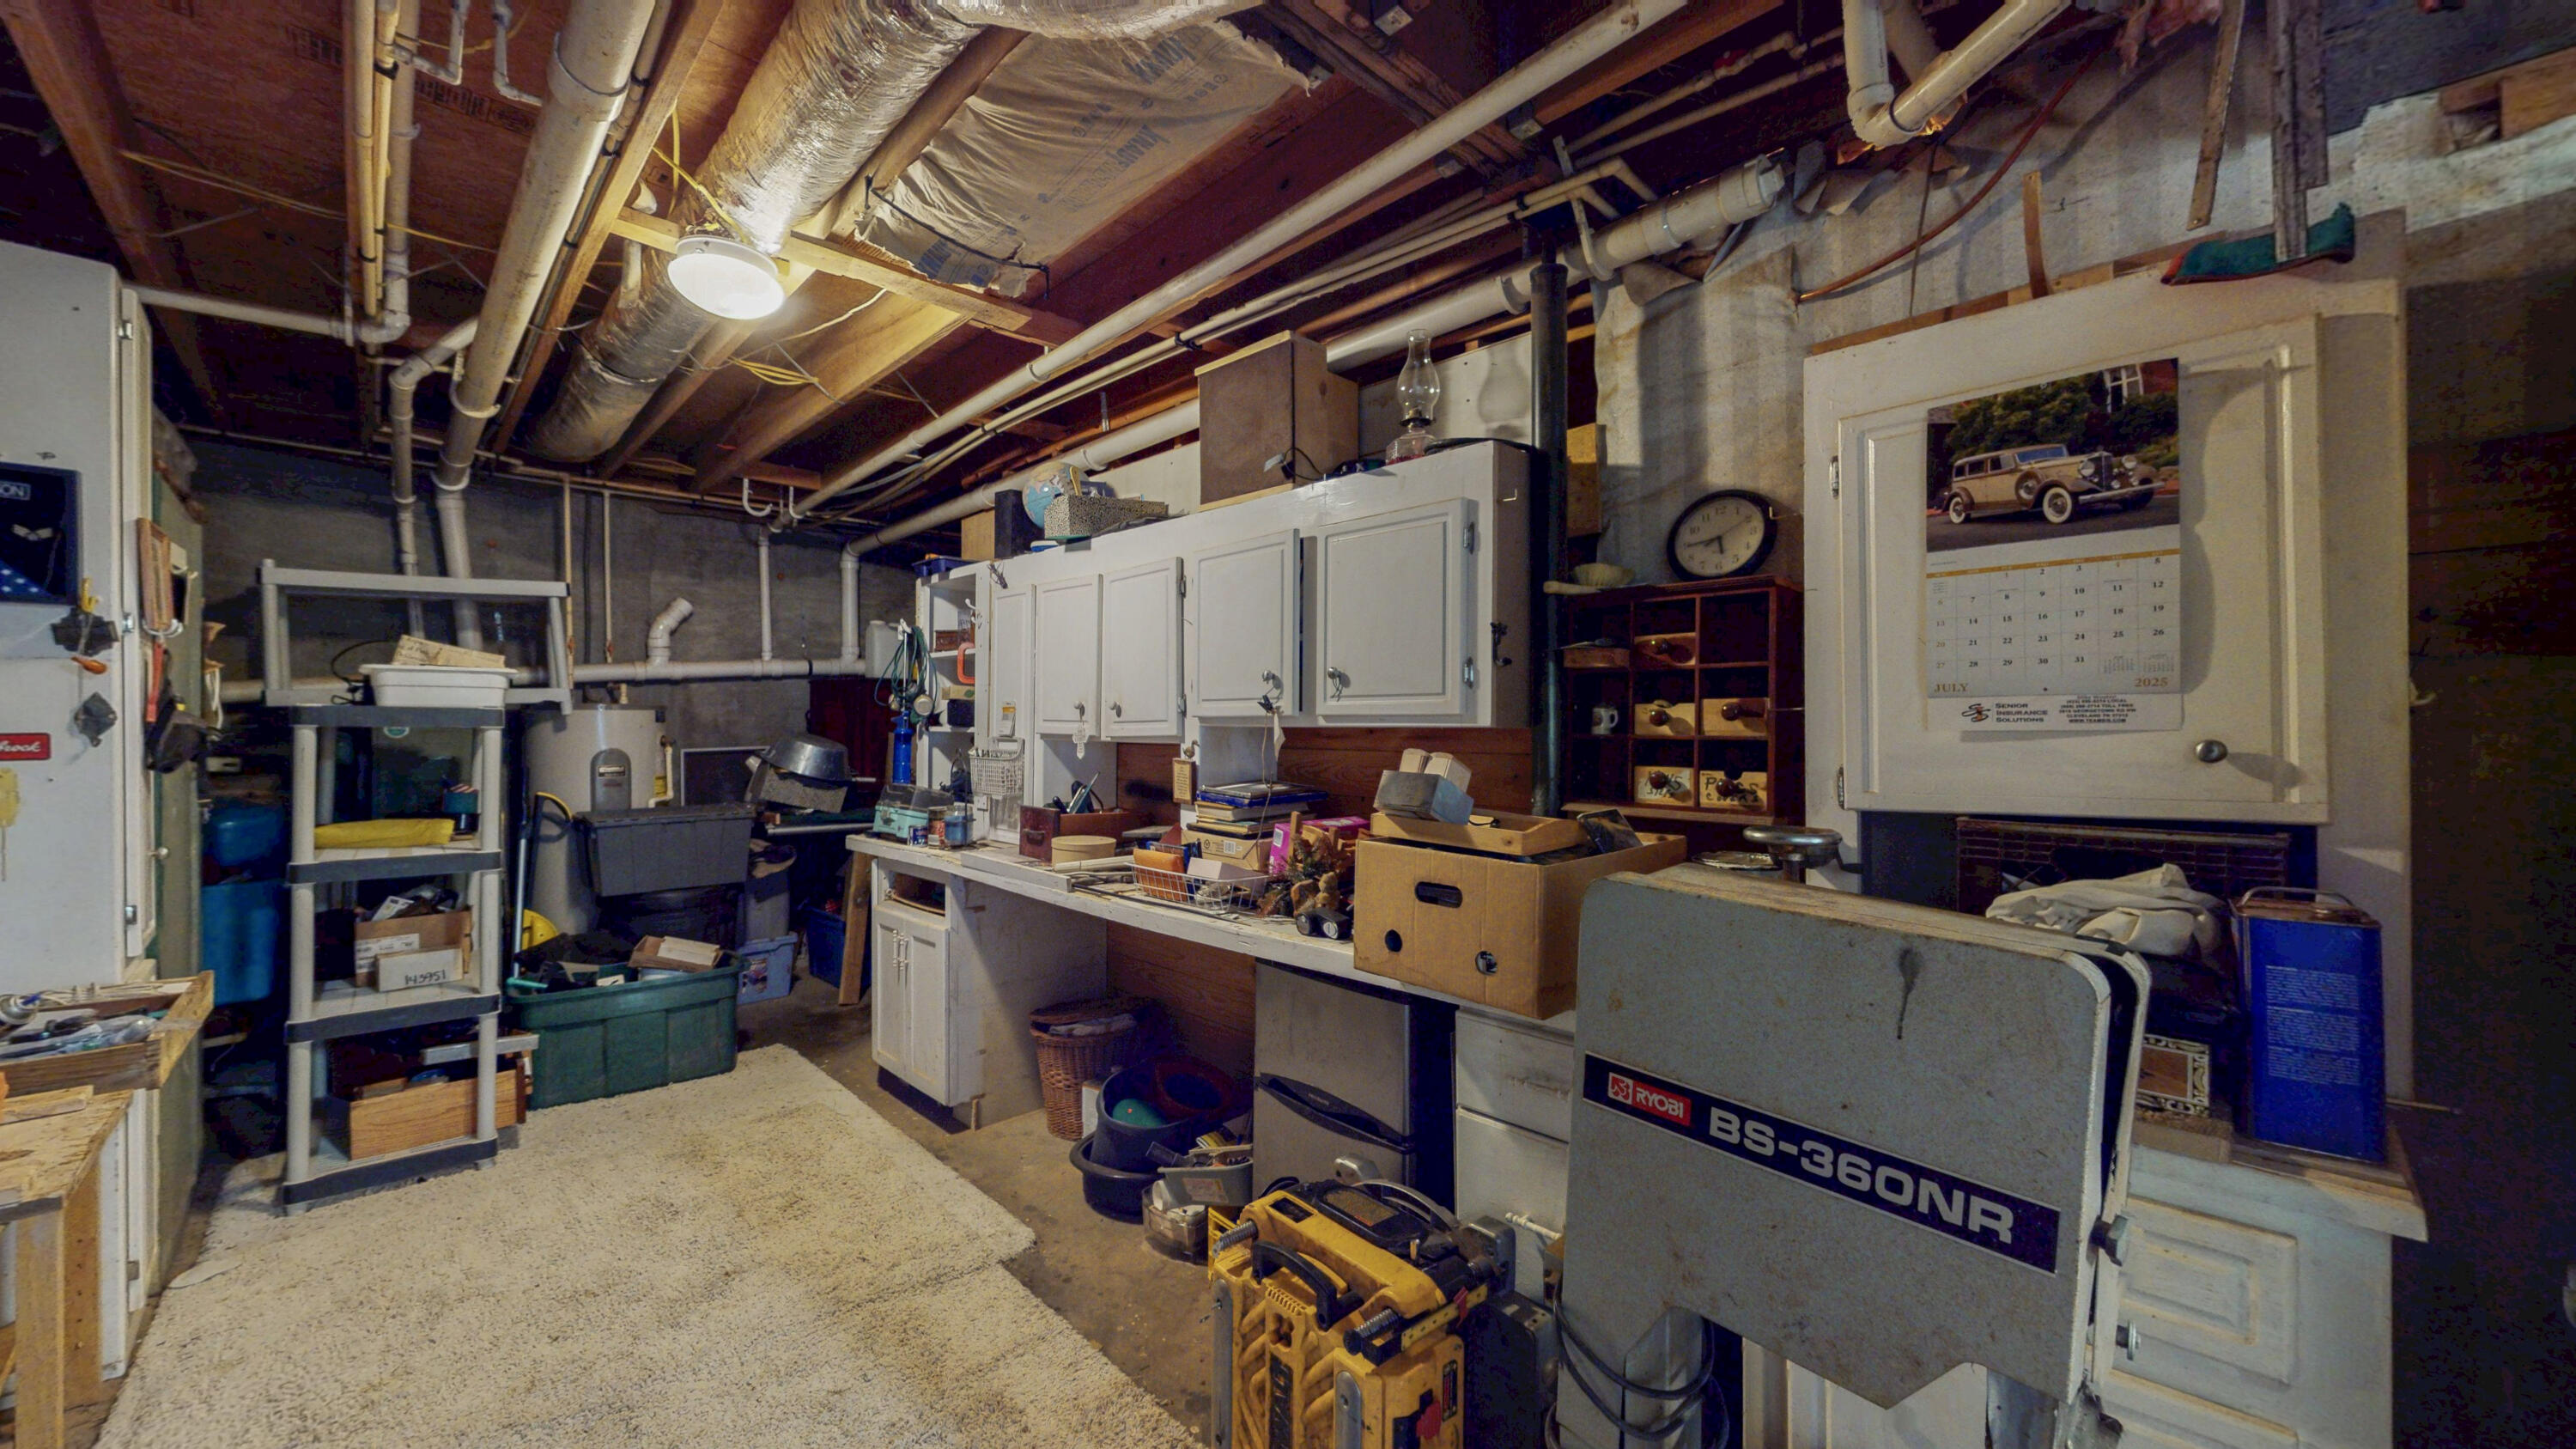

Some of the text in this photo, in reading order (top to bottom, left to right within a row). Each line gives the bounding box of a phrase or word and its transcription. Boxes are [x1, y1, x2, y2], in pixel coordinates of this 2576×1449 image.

[1934, 683, 1969, 693] JULY
[2134, 677, 2169, 687] 2025
[1635, 1086, 1685, 1120] RYOBI
[1709, 1105, 2014, 1245] BS-360NR
